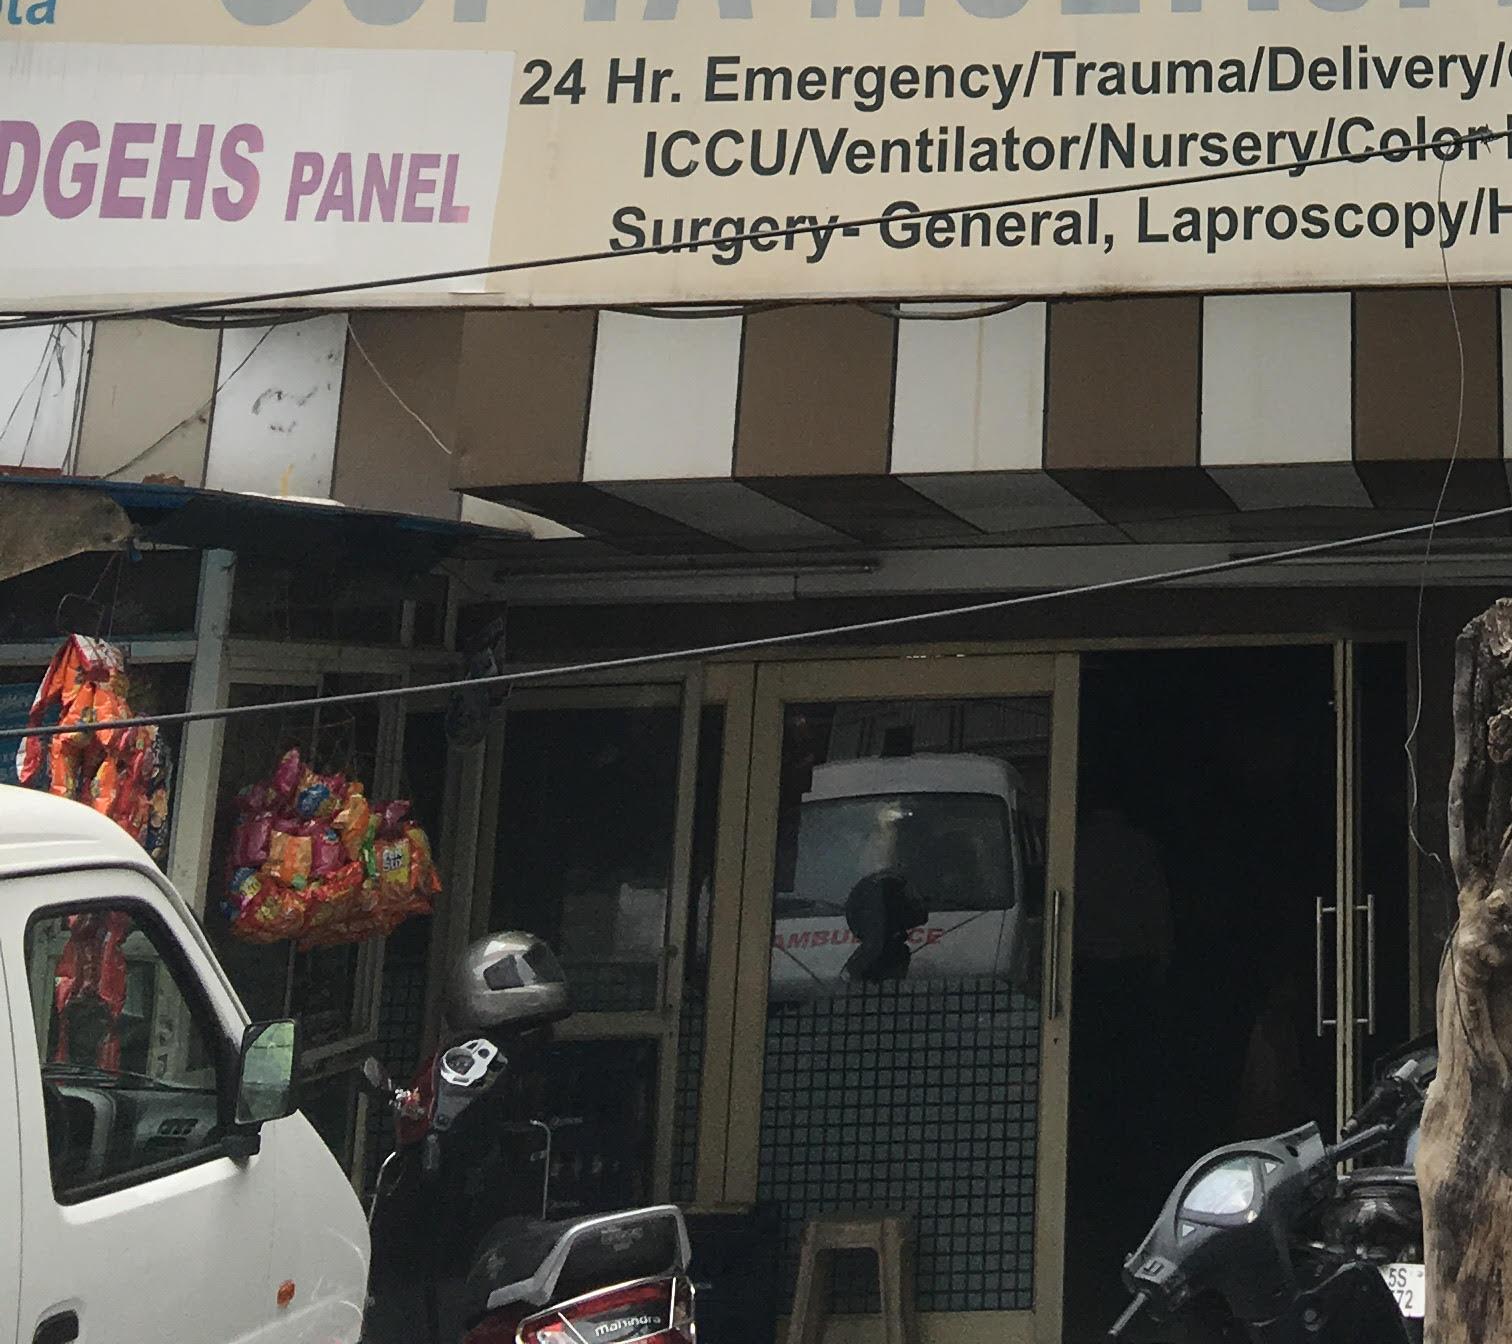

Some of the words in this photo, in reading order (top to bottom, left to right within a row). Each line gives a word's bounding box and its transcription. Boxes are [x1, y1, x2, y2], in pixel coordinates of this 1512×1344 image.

[519, 58, 586, 106] 24
[607, 56, 681, 104] Hr.
[0, 119, 265, 222] DGEHS
[284, 151, 470, 224] PANEL
[609, 204, 861, 265] Surgery-
[879, 198, 1115, 255] General,
[773, 928, 945, 950] AMBUCE
[594, 1315, 661, 1337] mahindra
